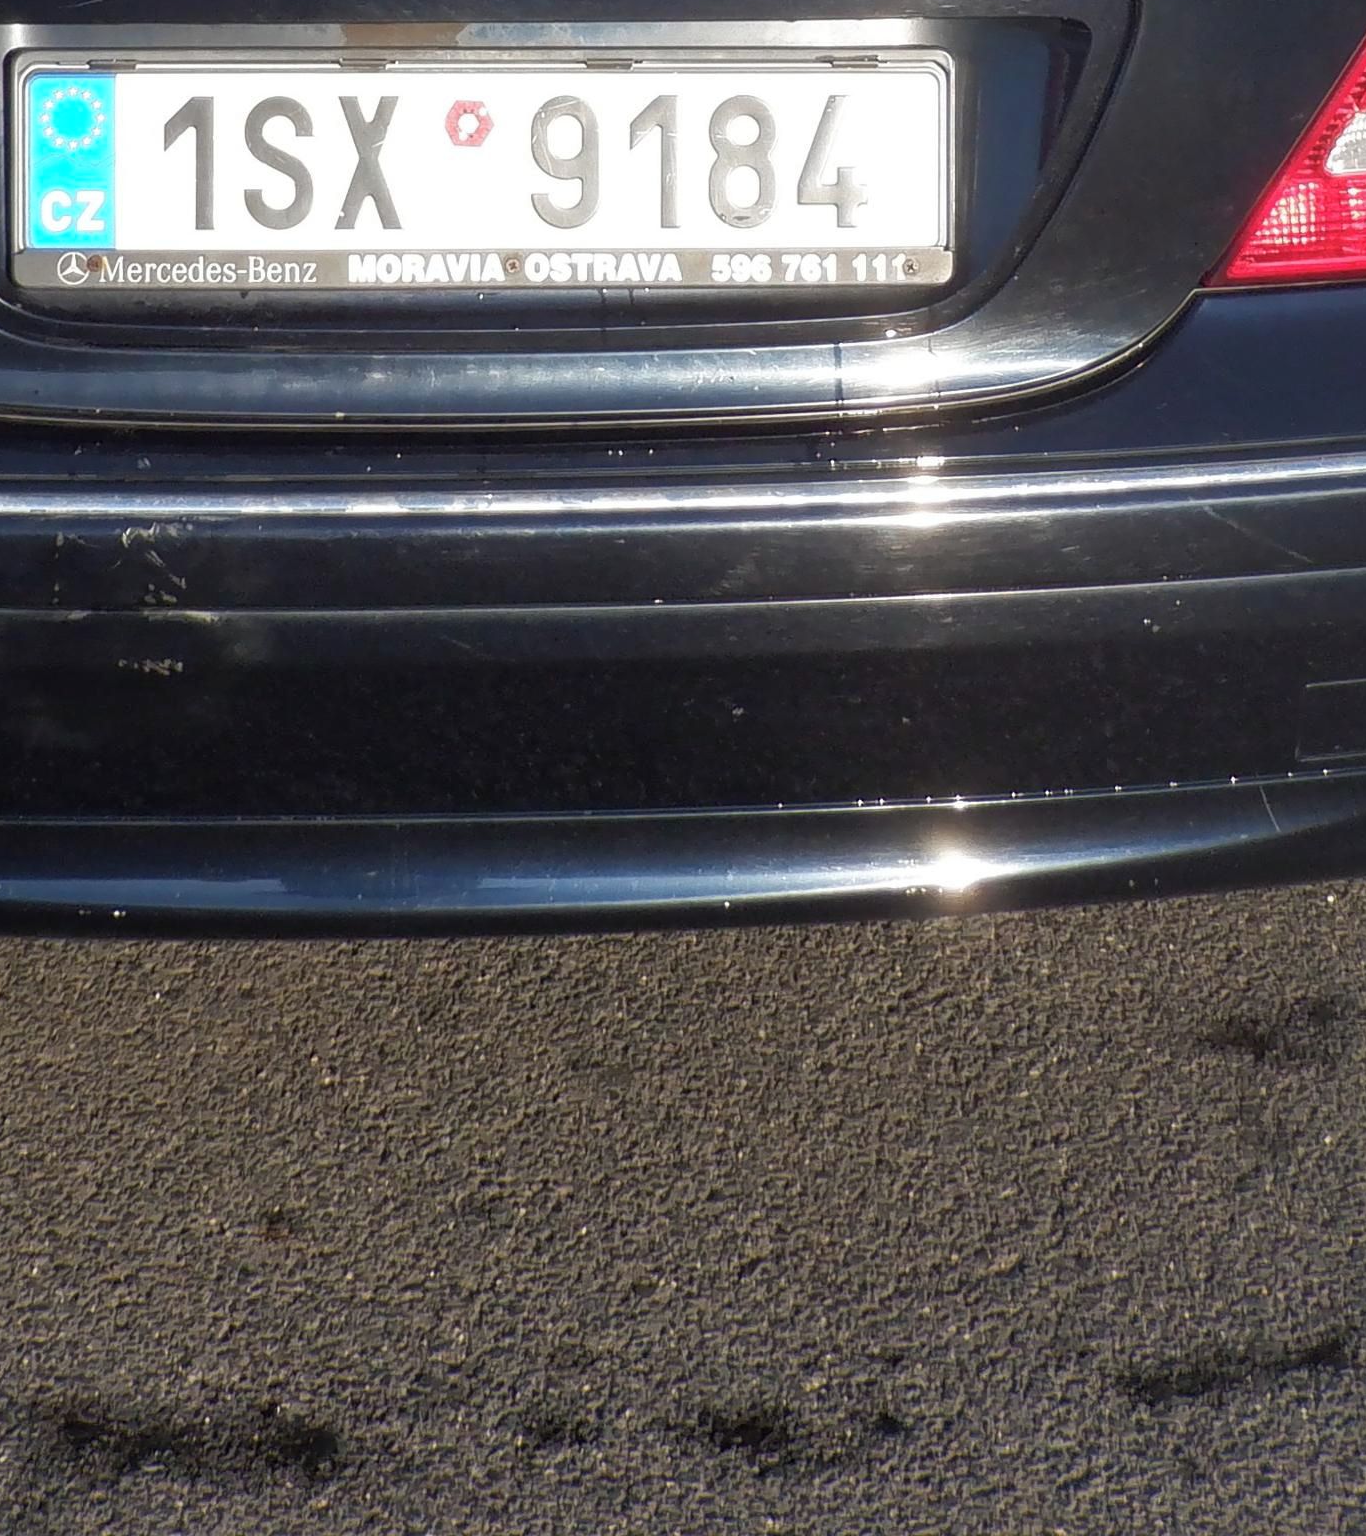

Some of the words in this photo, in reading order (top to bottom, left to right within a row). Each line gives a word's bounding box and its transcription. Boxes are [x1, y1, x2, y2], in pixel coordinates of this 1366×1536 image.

[164, 95, 403, 230] 1SX
[530, 94, 869, 229] 9184
[40, 189, 107, 233] CZ
[98, 256, 318, 284] Mercedes-Benz
[348, 253, 506, 283] MORAVIA
[524, 253, 683, 283] OSTRAVA
[710, 253, 773, 283] 596
[782, 253, 837, 283] 761
[852, 252, 907, 282] 111
